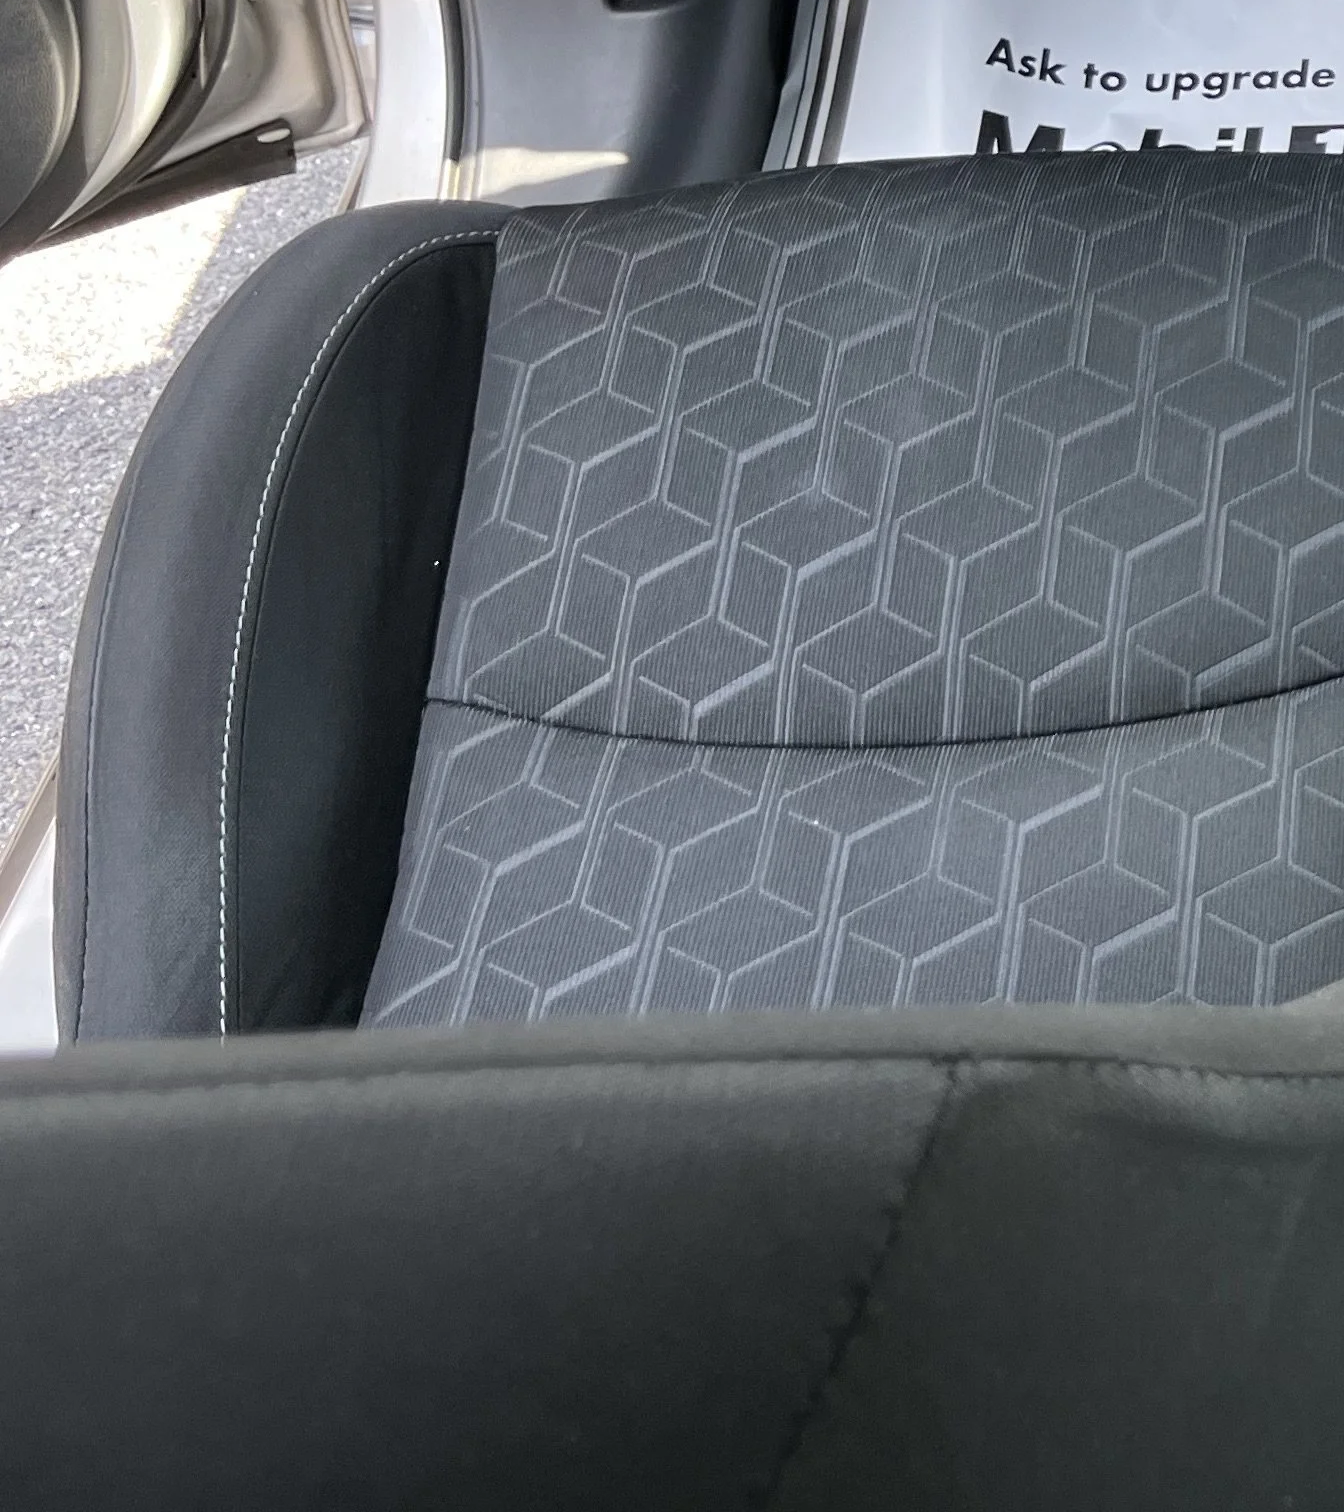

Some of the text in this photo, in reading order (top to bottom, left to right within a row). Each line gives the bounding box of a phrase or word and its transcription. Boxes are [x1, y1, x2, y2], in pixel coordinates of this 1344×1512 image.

[985, 36, 1068, 86] Ask
[1083, 62, 1128, 92] to
[1145, 58, 1336, 101] upgrade
